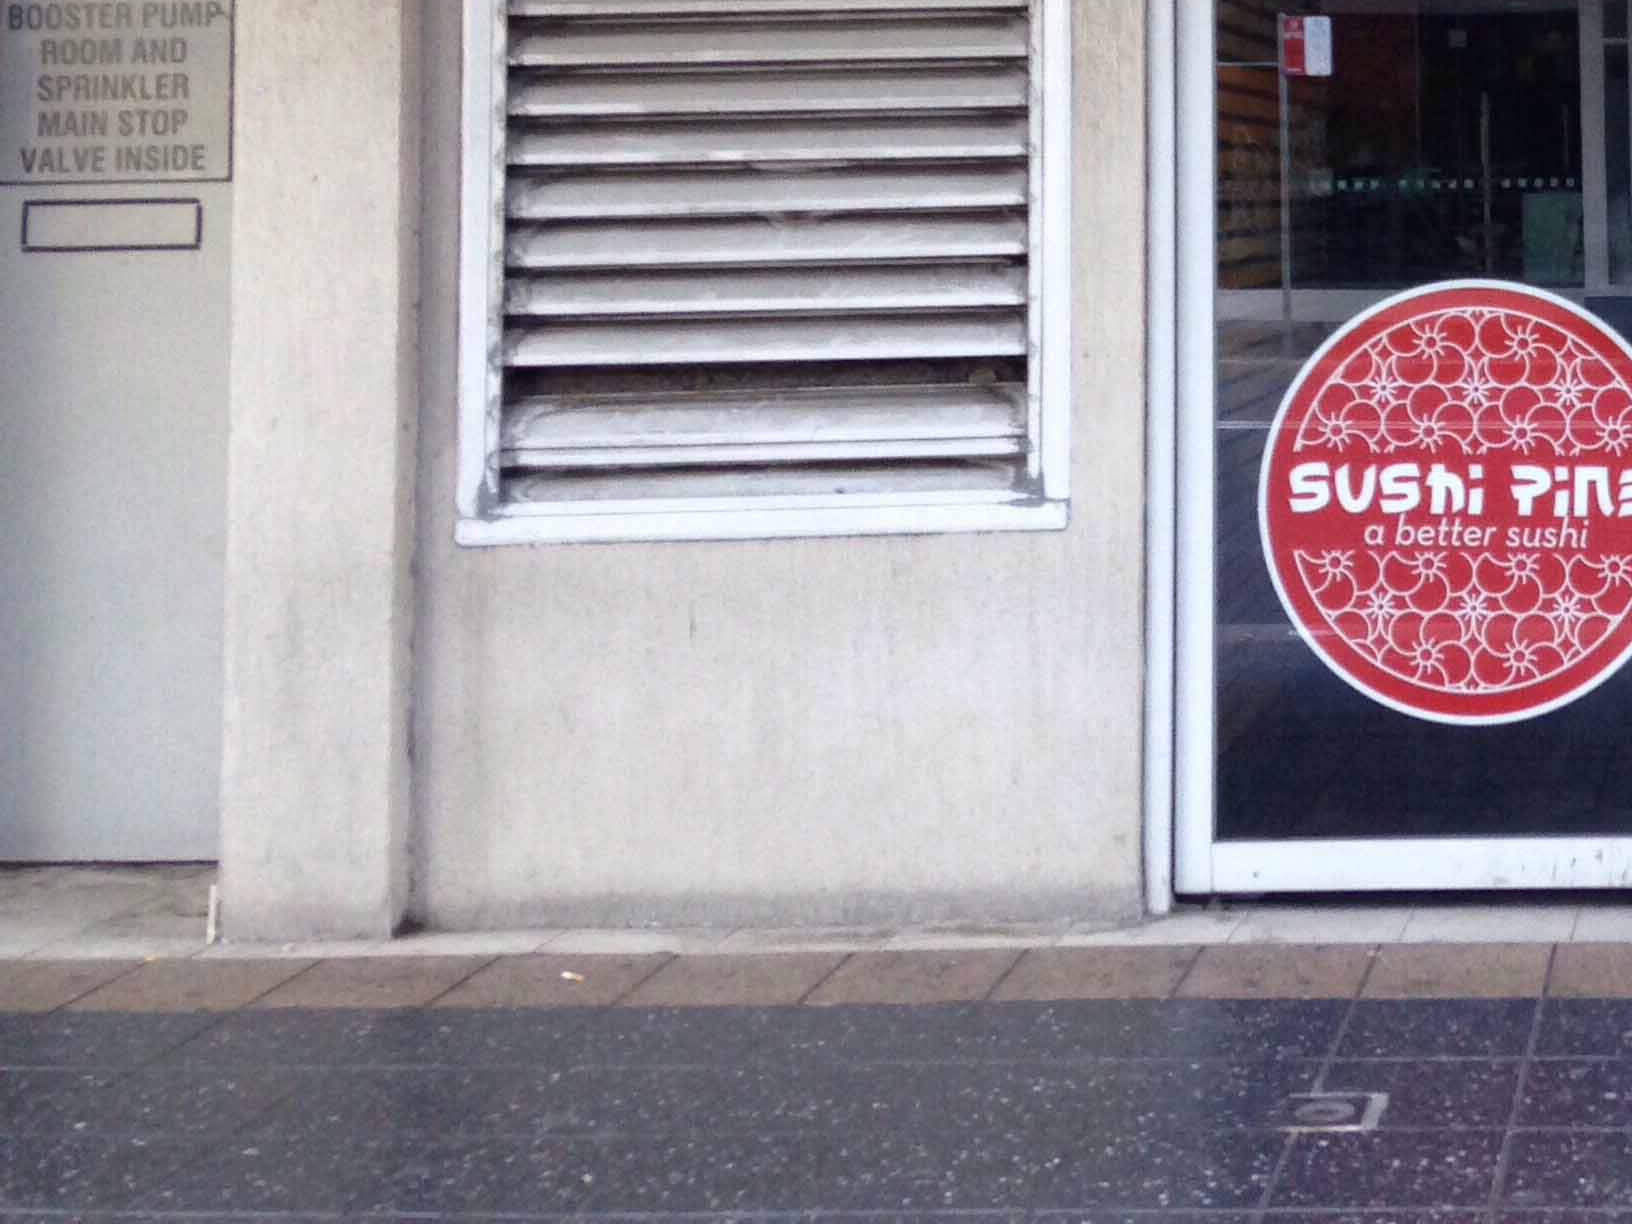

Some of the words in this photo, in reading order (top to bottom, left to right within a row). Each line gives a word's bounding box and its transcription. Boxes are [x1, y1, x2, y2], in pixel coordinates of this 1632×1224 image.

[8, 1, 132, 30] BOOSTER
[142, 1, 223, 28] PUMP
[41, 38, 122, 65] ROOM
[131, 39, 188, 64] AND
[37, 74, 190, 101] SPRINKLER
[37, 110, 107, 137] MAIN
[118, 109, 188, 136] STOP
[19, 146, 105, 173] VALVE
[115, 145, 206, 172] INSIDE
[1363, 525, 1384, 546] a
[1395, 512, 1497, 547] better
[1505, 516, 1590, 549] sushi
